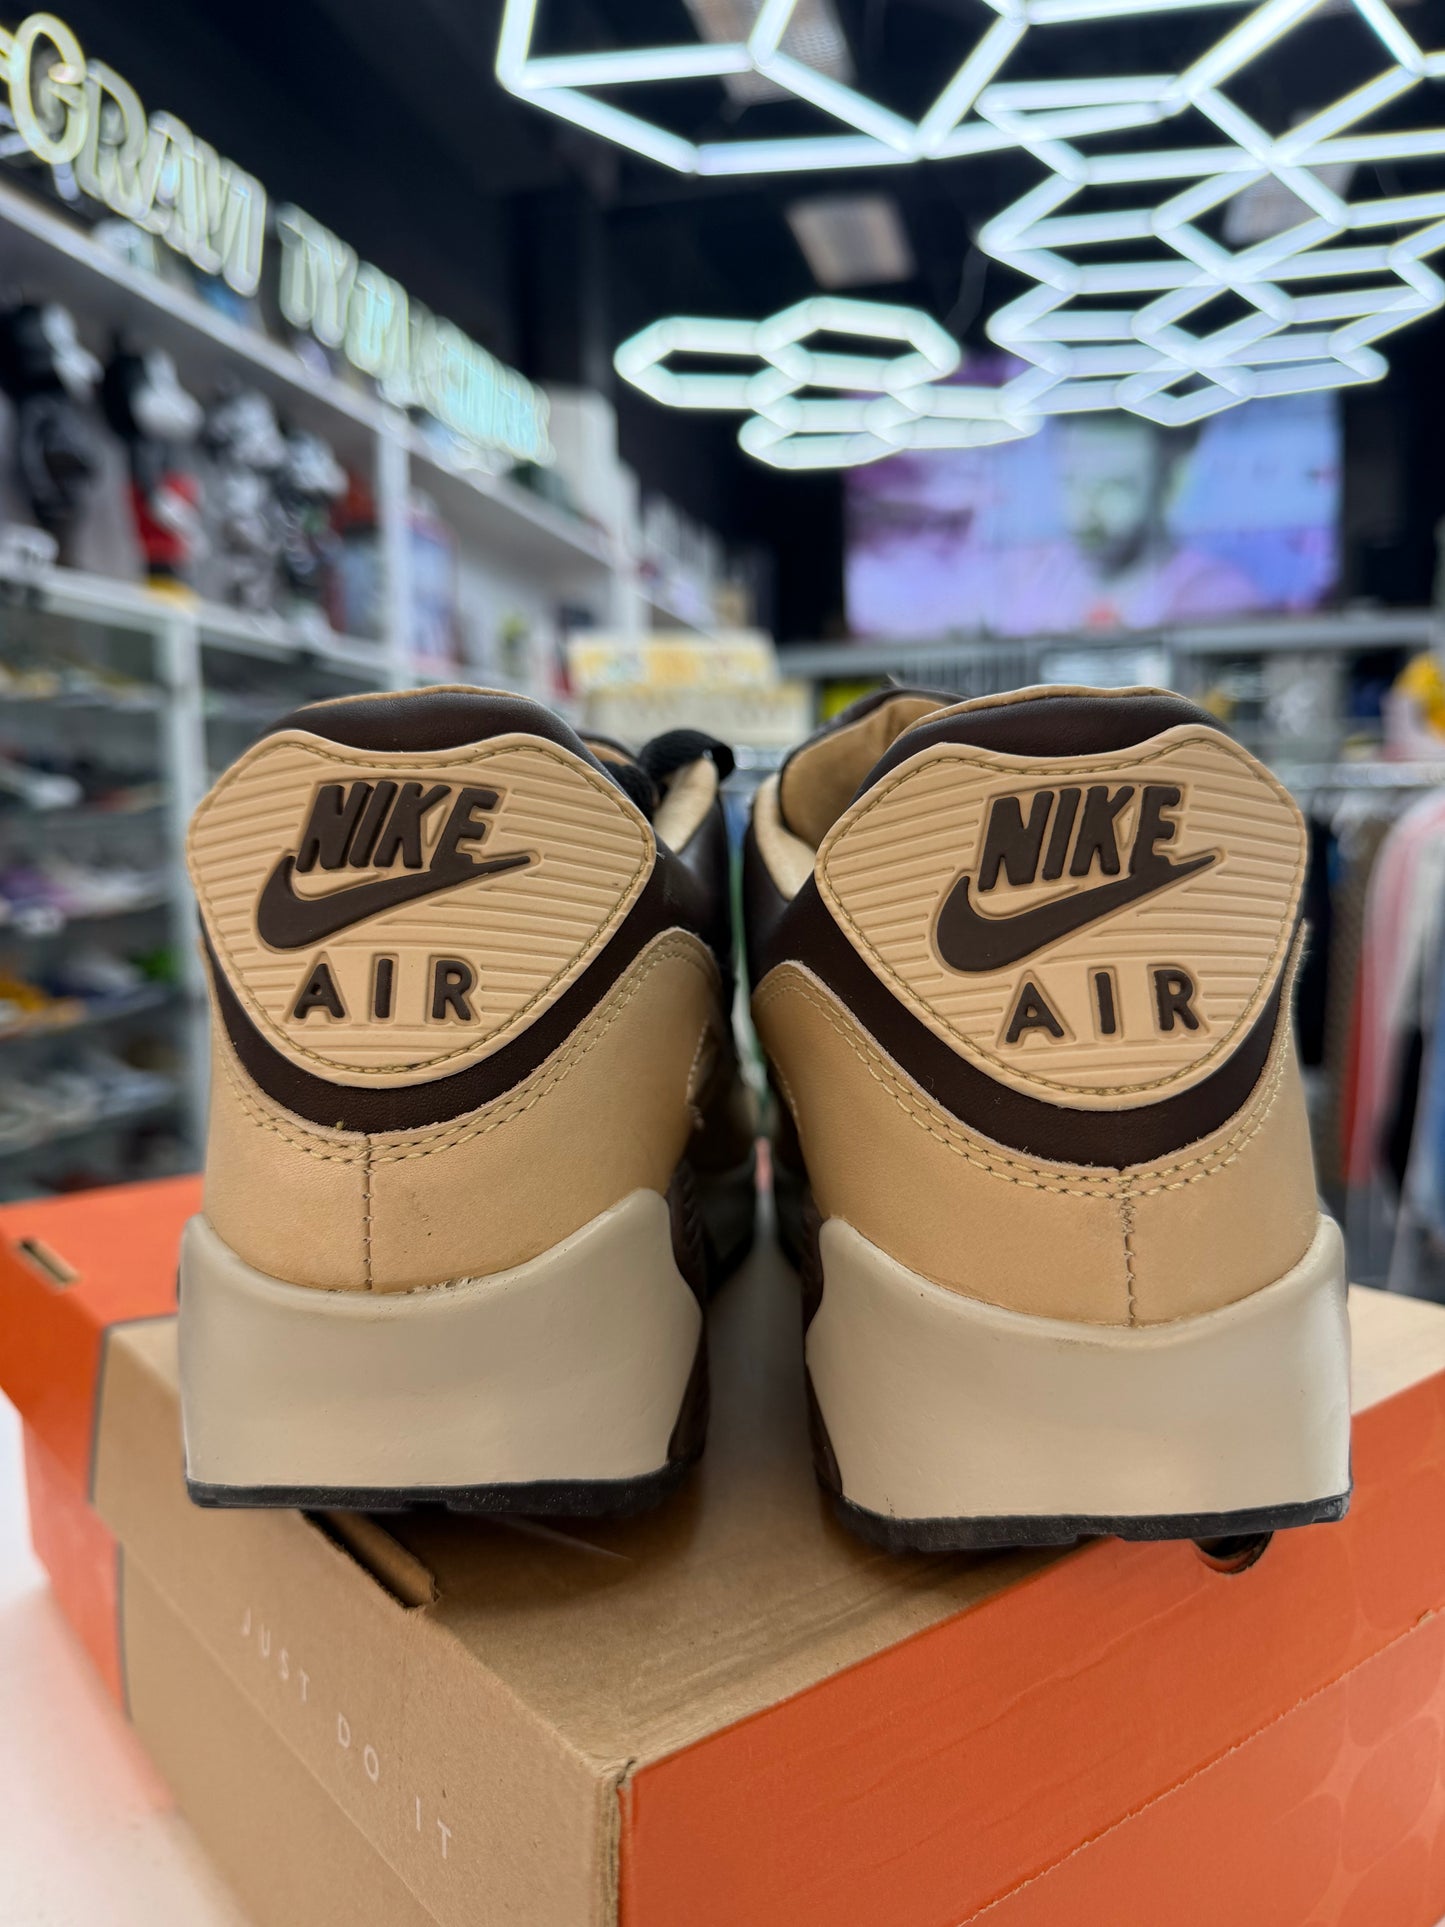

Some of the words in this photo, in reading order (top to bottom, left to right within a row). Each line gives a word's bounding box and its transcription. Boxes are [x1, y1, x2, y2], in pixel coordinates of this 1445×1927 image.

[296, 781, 499, 873] NIKE
[978, 785, 1181, 893] NIKE
[293, 958, 473, 1021] AIR
[1005, 968, 1200, 1043] AIR
[241, 1607, 310, 1704] JUST
[337, 1712, 380, 1782] DO
[415, 1795, 452, 1860] IT
